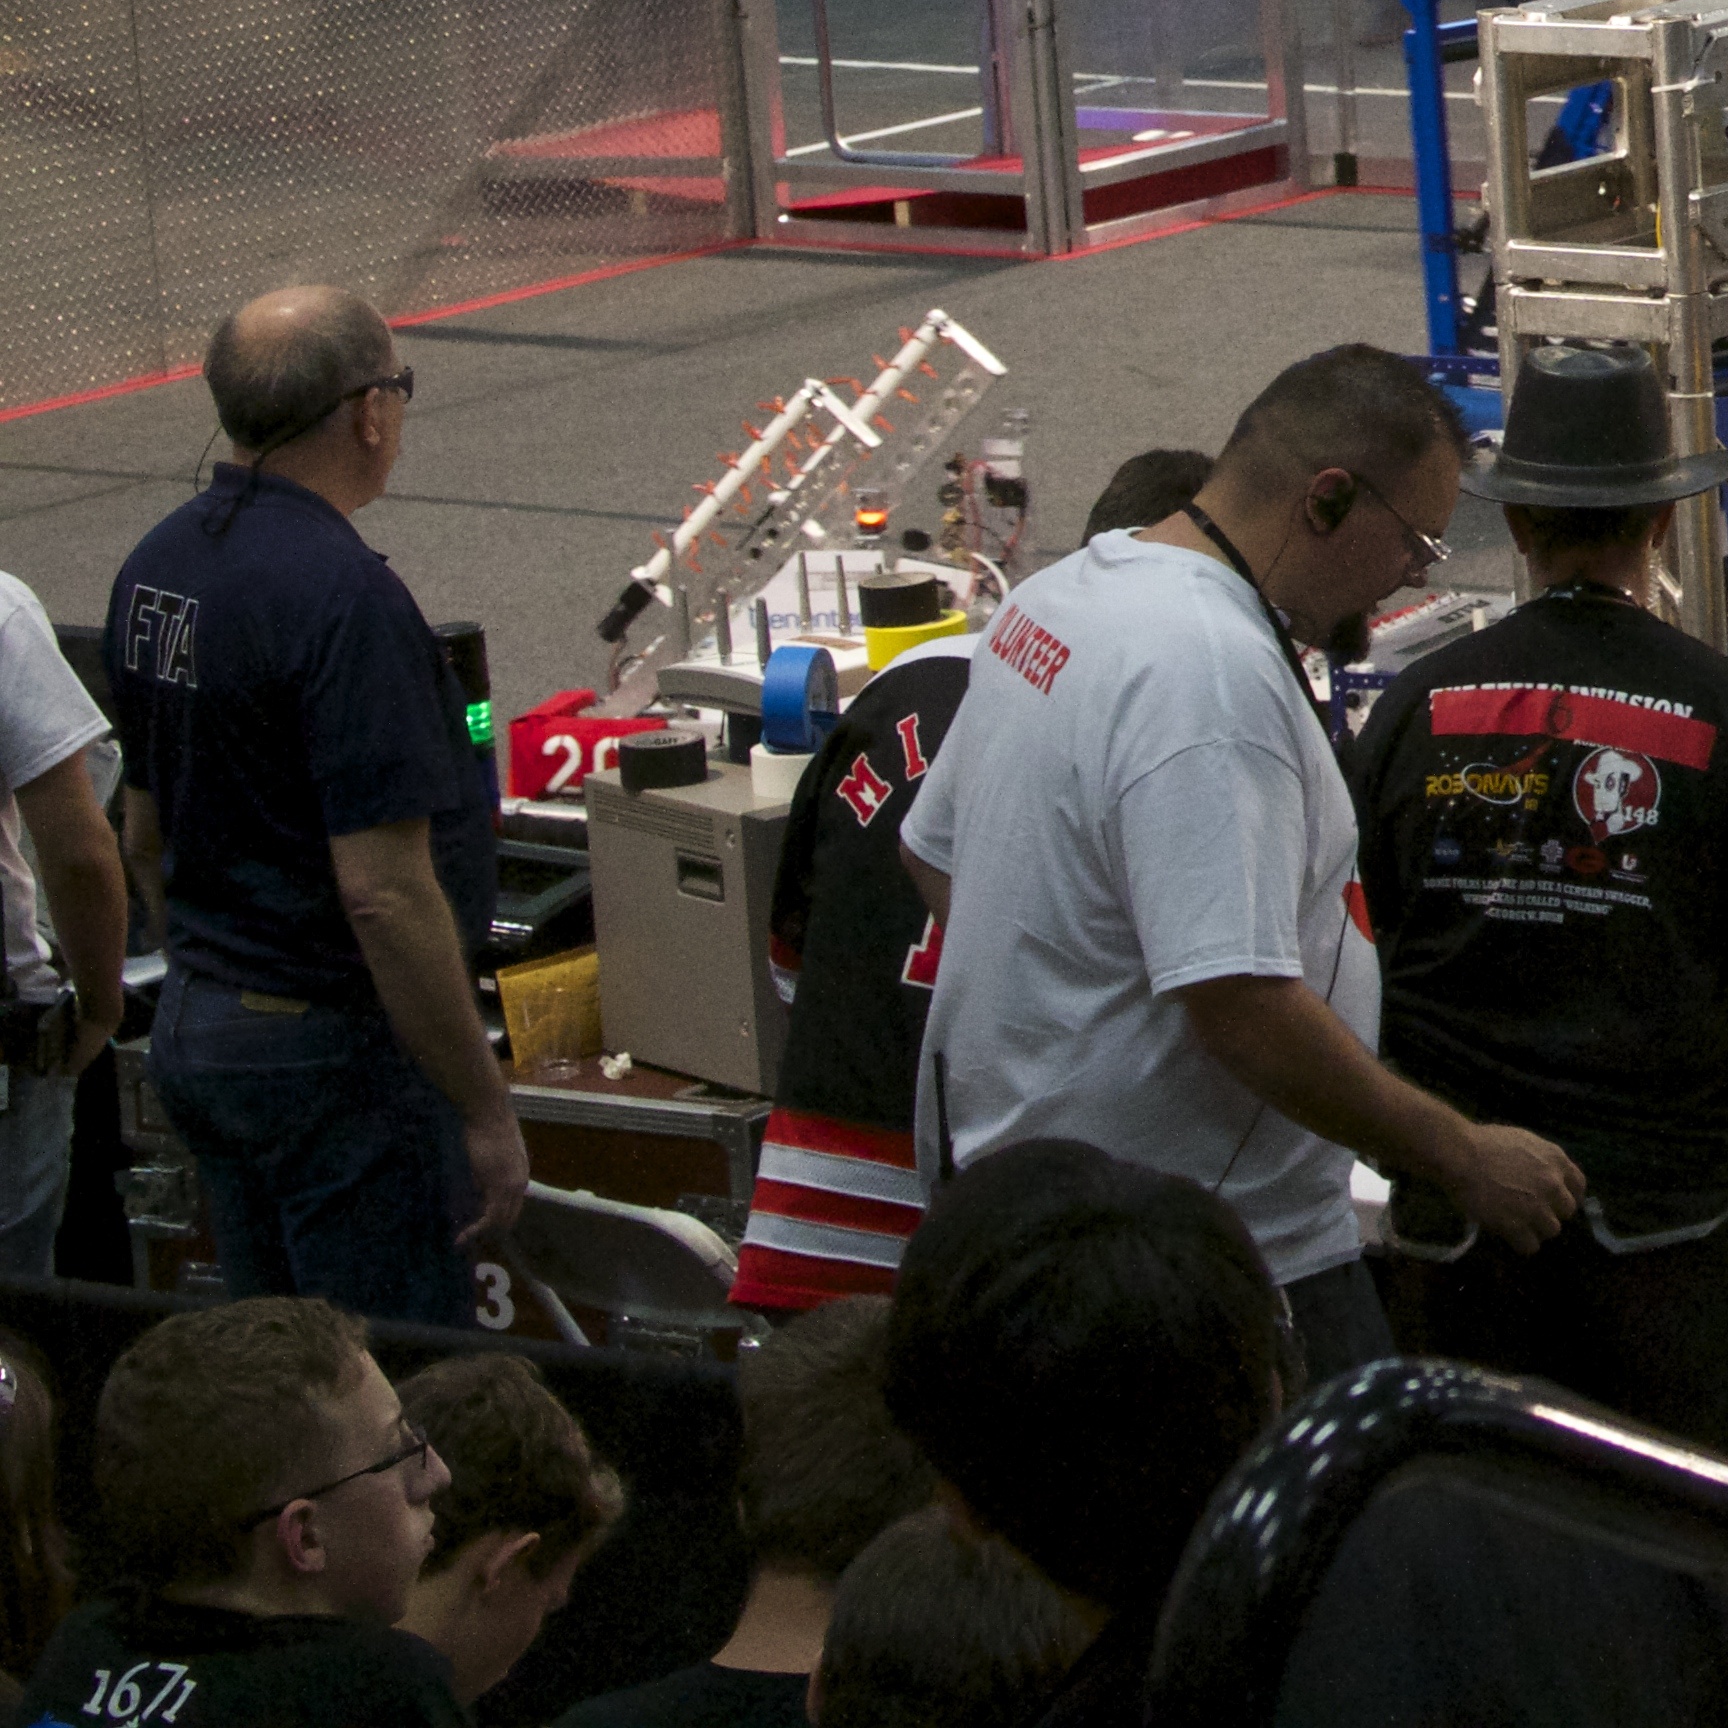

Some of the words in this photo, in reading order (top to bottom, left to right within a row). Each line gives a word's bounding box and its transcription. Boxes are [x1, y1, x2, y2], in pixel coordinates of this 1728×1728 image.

[126, 583, 200, 688] FTA
[1624, 805, 1660, 826] 148
[474, 1262, 516, 1331] 3
[82, 1661, 197, 1724] 1671
